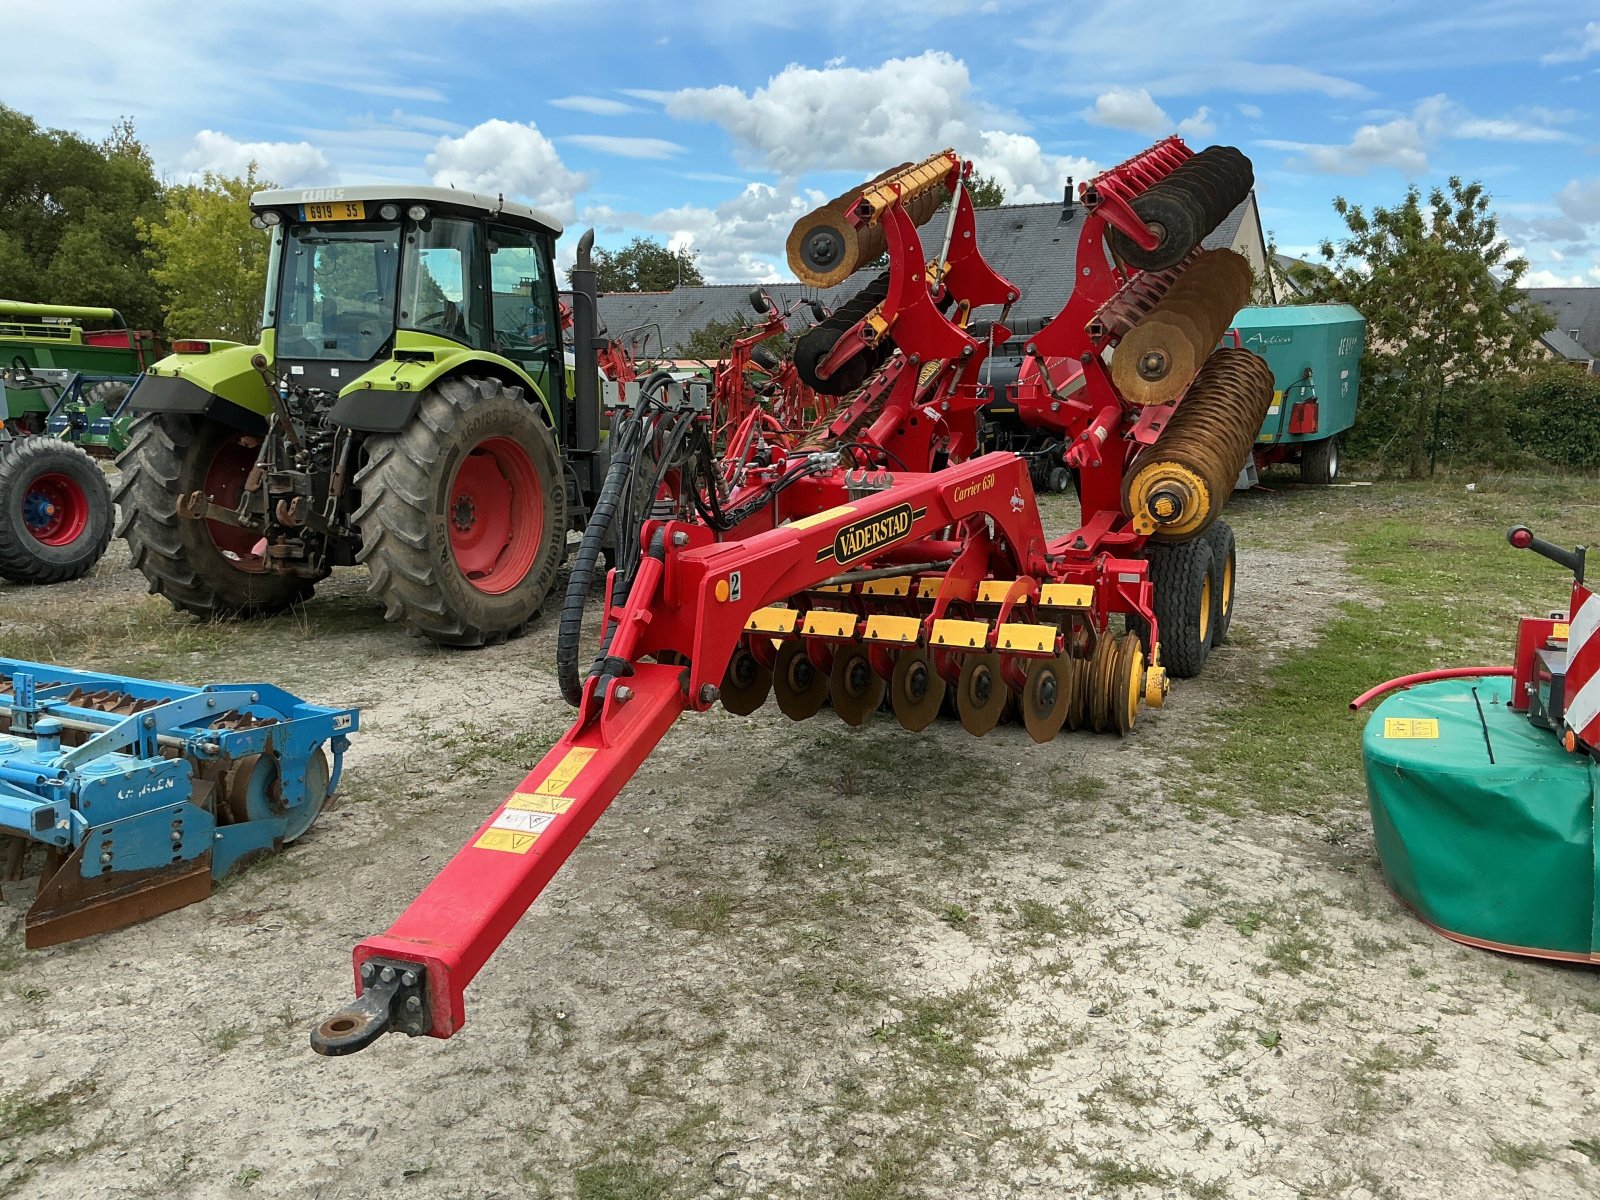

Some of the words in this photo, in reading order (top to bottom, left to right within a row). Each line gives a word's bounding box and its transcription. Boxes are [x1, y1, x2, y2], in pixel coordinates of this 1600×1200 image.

[301, 189, 345, 202] CLAAS
[310, 205, 333, 219] 6919
[345, 203, 358, 217] 35
[953, 481, 982, 503] Carrier
[982, 473, 995, 491] 650
[840, 511, 909, 557] VÄDERSTAD
[731, 573, 740, 596] 2
[117, 778, 174, 800] LEEN
